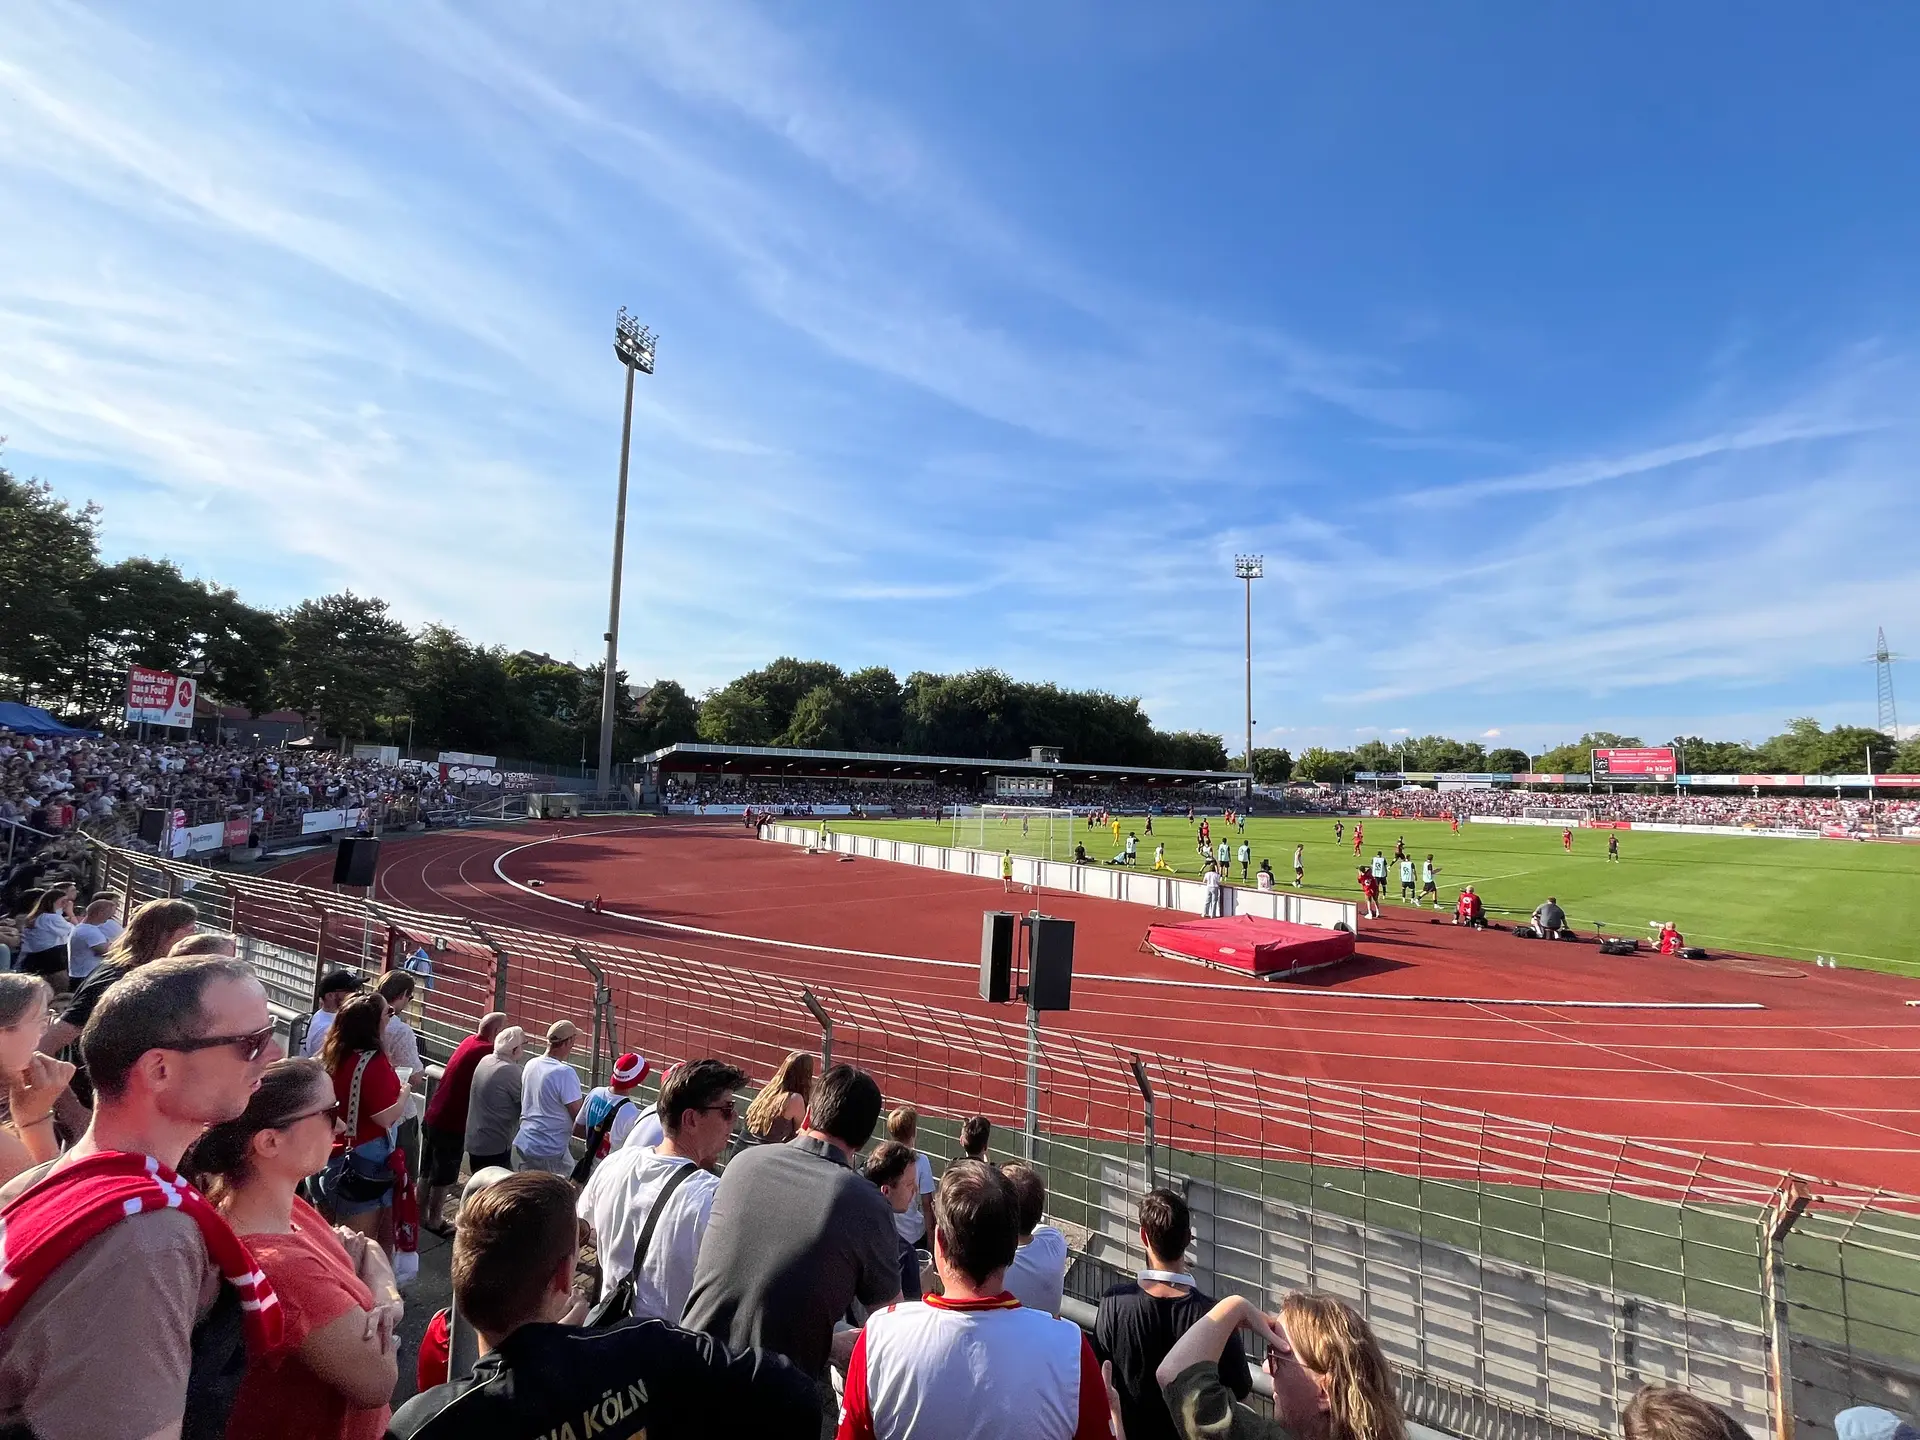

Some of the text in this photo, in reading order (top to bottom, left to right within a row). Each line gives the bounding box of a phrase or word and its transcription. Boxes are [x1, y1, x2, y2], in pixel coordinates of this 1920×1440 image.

[133, 671, 175, 686] Riecht stark
[150, 685, 168, 695] Foul?
[583, 1378, 649, 1439] KÖLN
